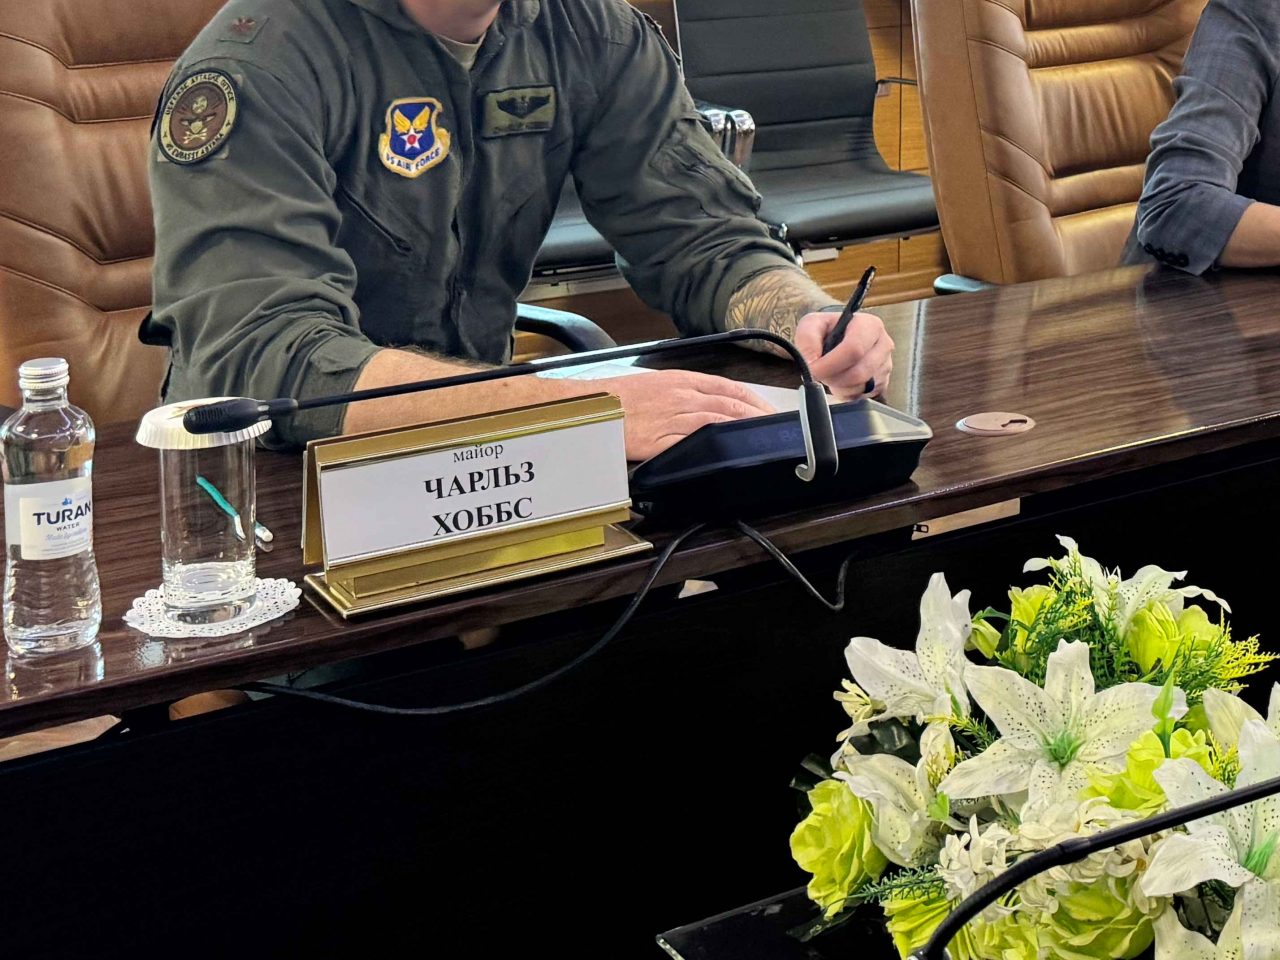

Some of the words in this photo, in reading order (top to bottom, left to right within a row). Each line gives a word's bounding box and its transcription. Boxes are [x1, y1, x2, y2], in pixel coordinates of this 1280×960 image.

[415, 147, 440, 170] FORCE
[453, 444, 504, 463] майор
[424, 461, 535, 500] ЧАРЛЬЗ
[56, 522, 80, 532] WATER
[432, 497, 533, 536] ХОББС
